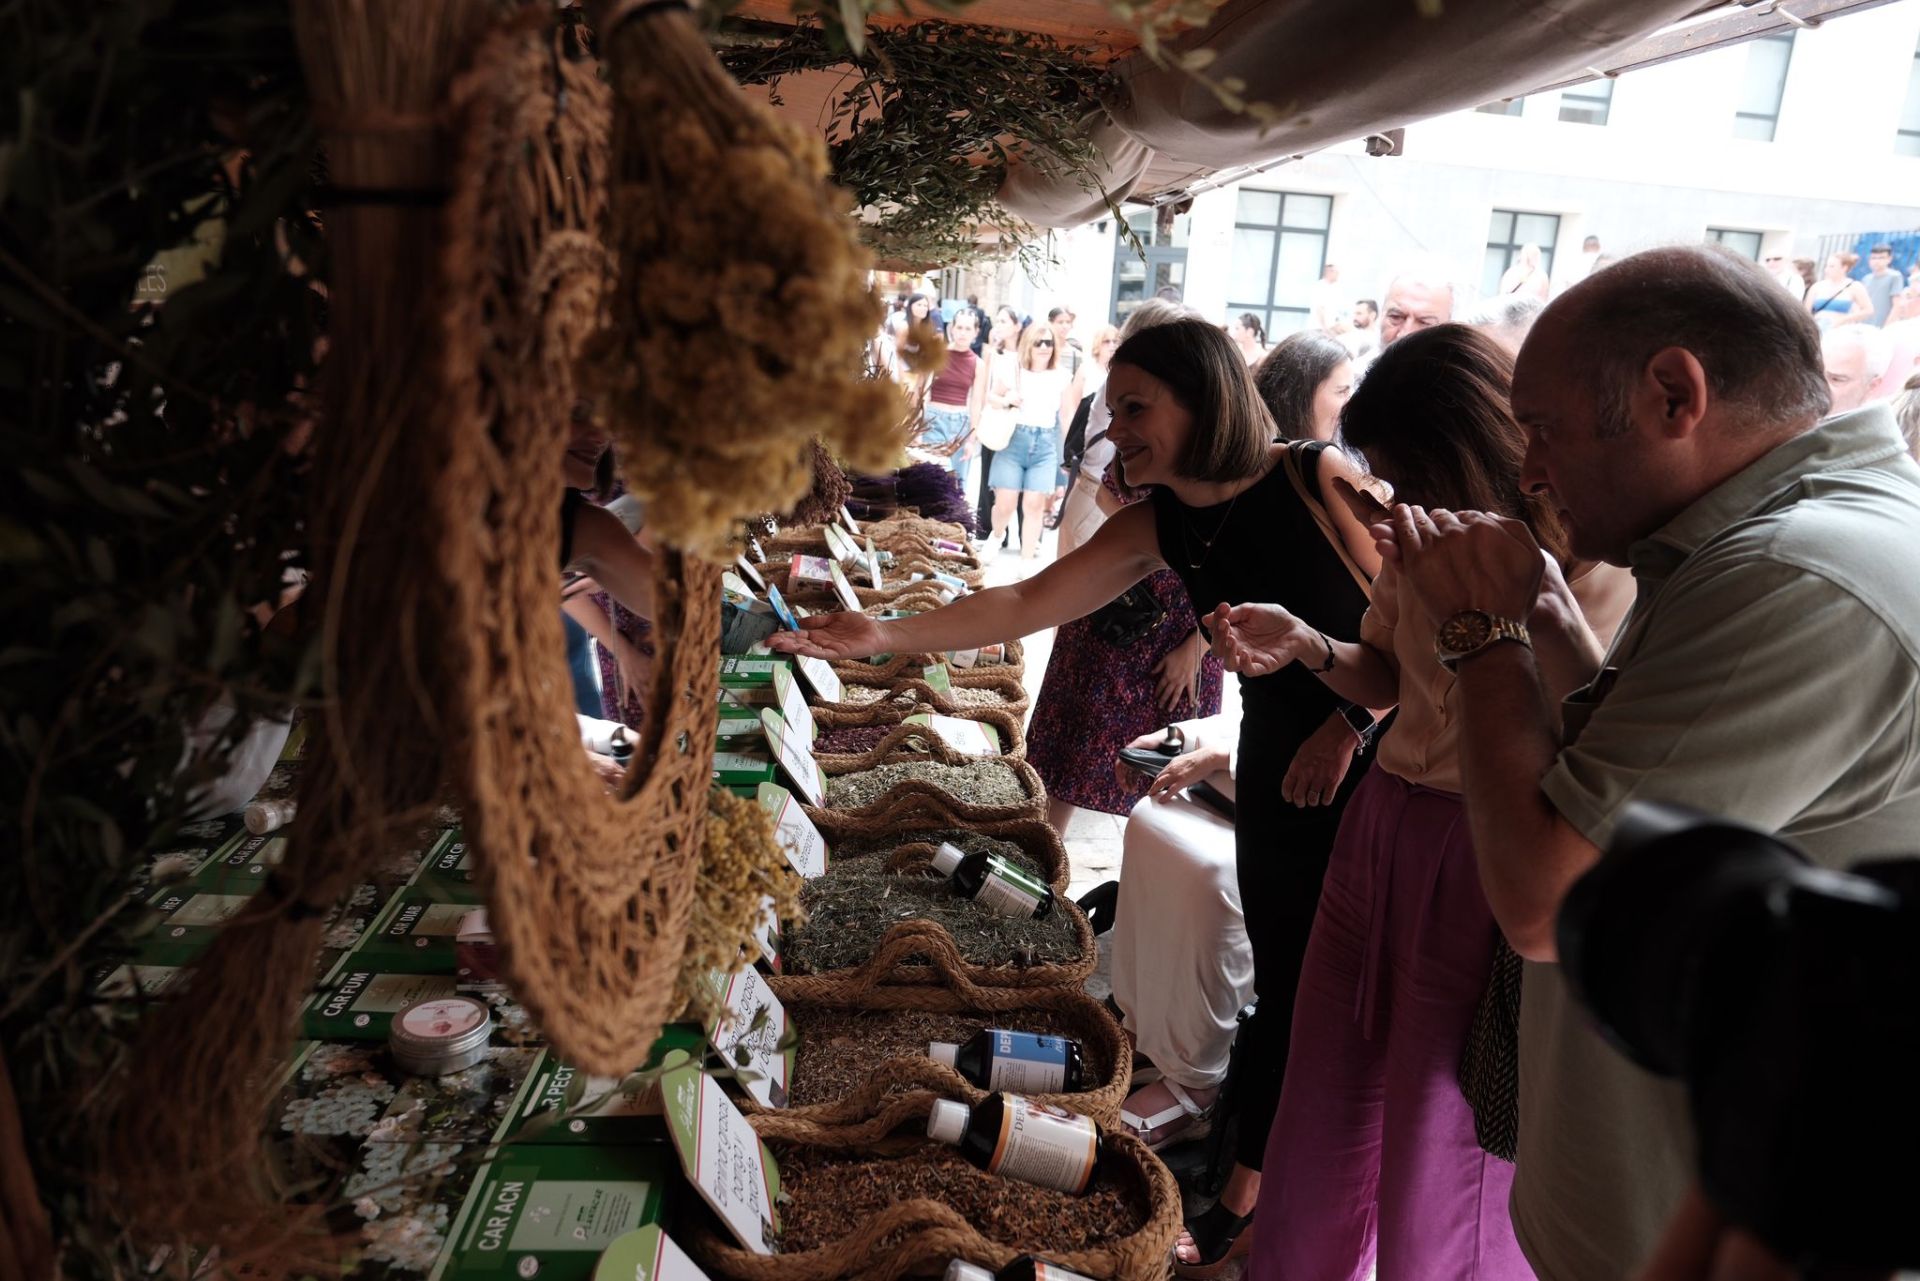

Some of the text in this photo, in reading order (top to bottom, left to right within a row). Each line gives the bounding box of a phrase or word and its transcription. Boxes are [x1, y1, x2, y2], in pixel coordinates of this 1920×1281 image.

[438, 853, 459, 870] CAR
[389, 921, 409, 936] CAR
[322, 971, 371, 1018] CAR FUM
[742, 971, 757, 1017] grasas
[546, 1065, 577, 1096] PECT
[713, 1149, 729, 1208] Eliminar
[478, 1181, 525, 1251] CAR ACN
